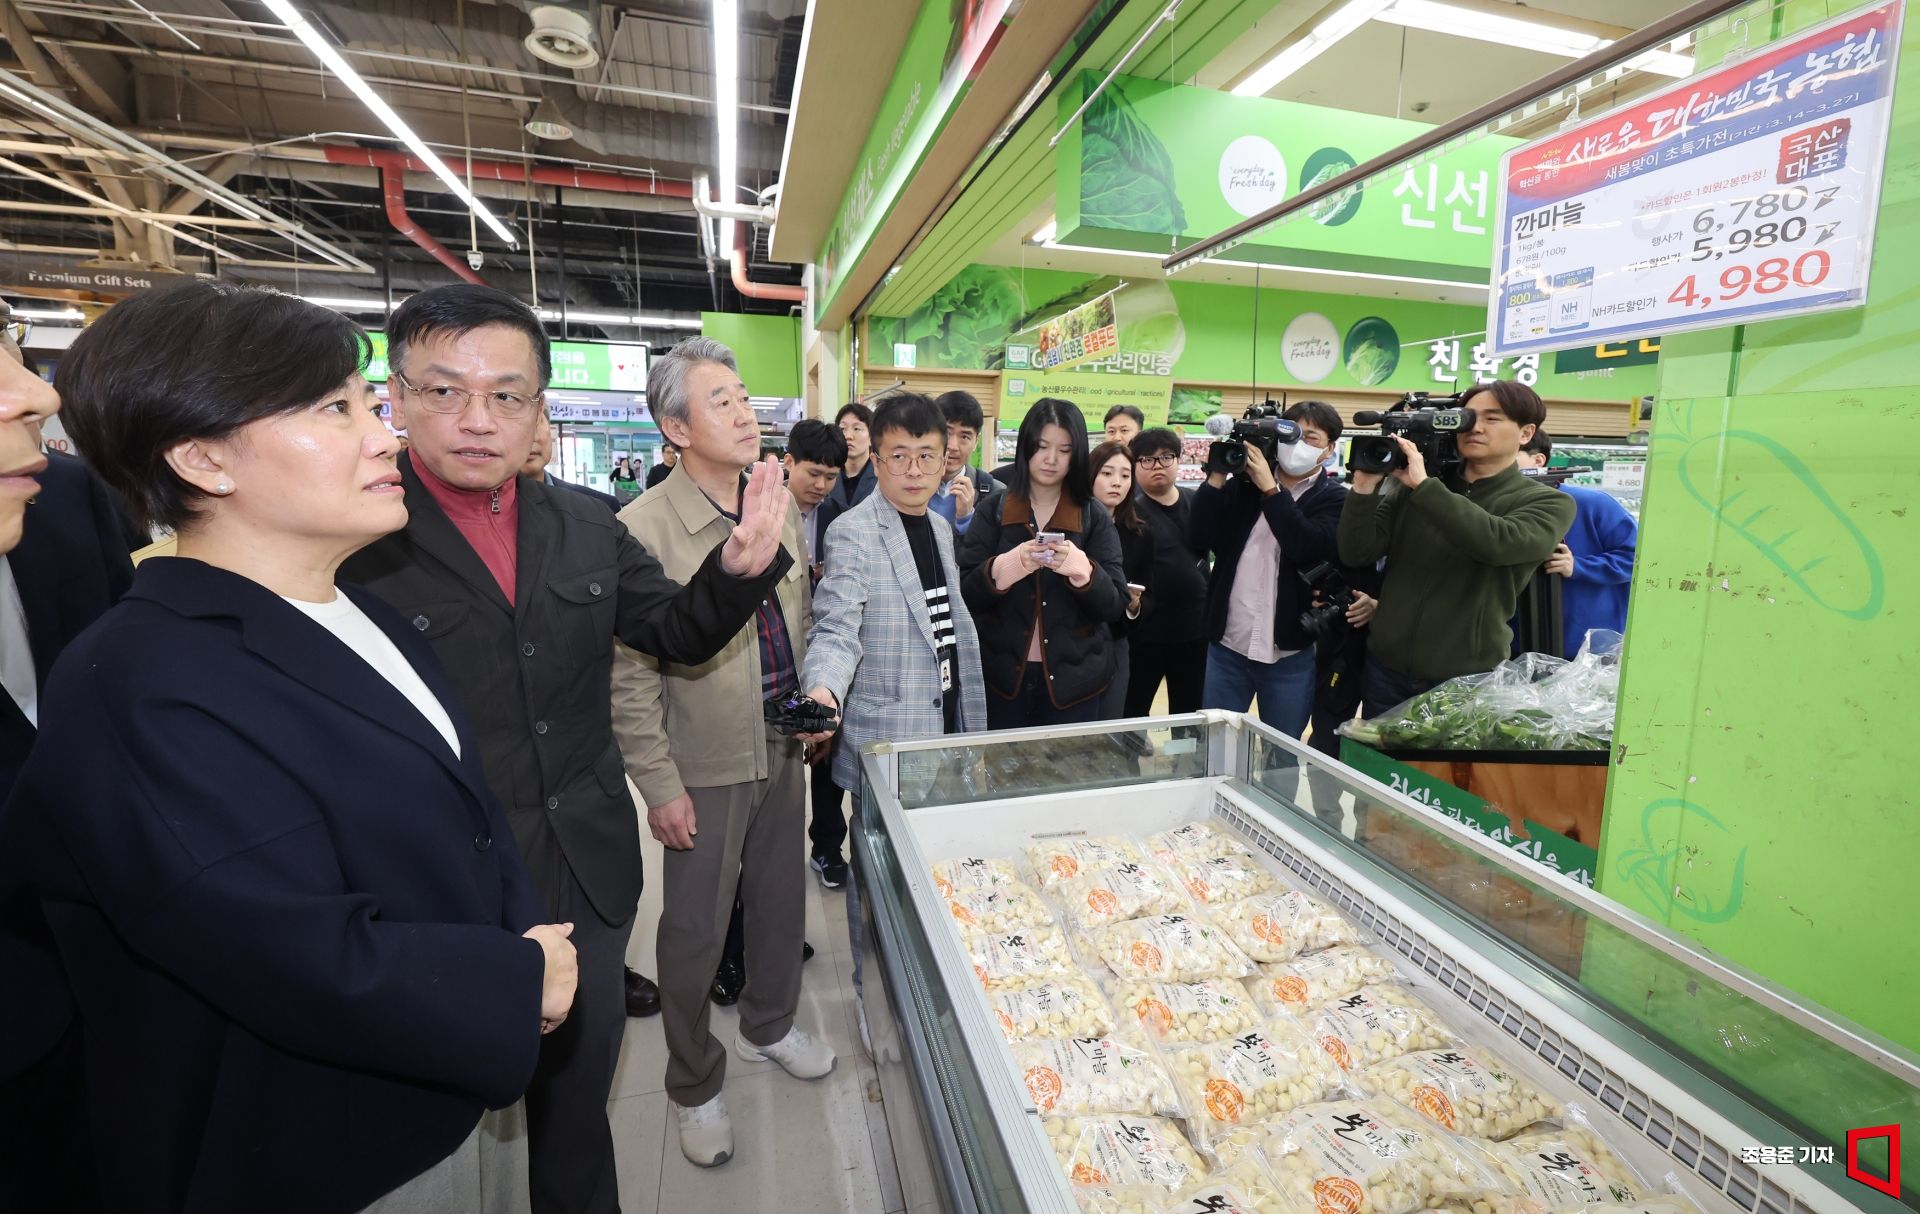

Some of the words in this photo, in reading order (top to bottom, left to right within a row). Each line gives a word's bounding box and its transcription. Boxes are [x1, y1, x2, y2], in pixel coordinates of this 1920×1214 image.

[1565, 120, 1641, 172] 새로운
[1647, 69, 1792, 138] 대한민국
[1804, 27, 1887, 93] 농협
[1604, 151, 1659, 181] 새봄맞이
[1664, 128, 1729, 162] 초특가전
[1787, 125, 1844, 156] 국산
[1784, 151, 1840, 180] 대표
[1519, 173, 1542, 189] 혁신을
[1391, 162, 1488, 236] 신선
[1692, 185, 1809, 237] 6,780
[1514, 201, 1586, 241] 깐마늘
[1651, 231, 1684, 247] 행사가
[1691, 216, 1807, 262] 5,980
[94, 274, 121, 286] Gift
[124, 276, 152, 289] Sets
[1667, 249, 1831, 309] 4,980
[1509, 292, 1531, 306] 800
[1561, 302, 1578, 314] NH
[1591, 297, 1657, 317] NH카드할인가
[1083, 324, 1116, 354] 로컬푸드
[1435, 414, 1458, 426] SBS
